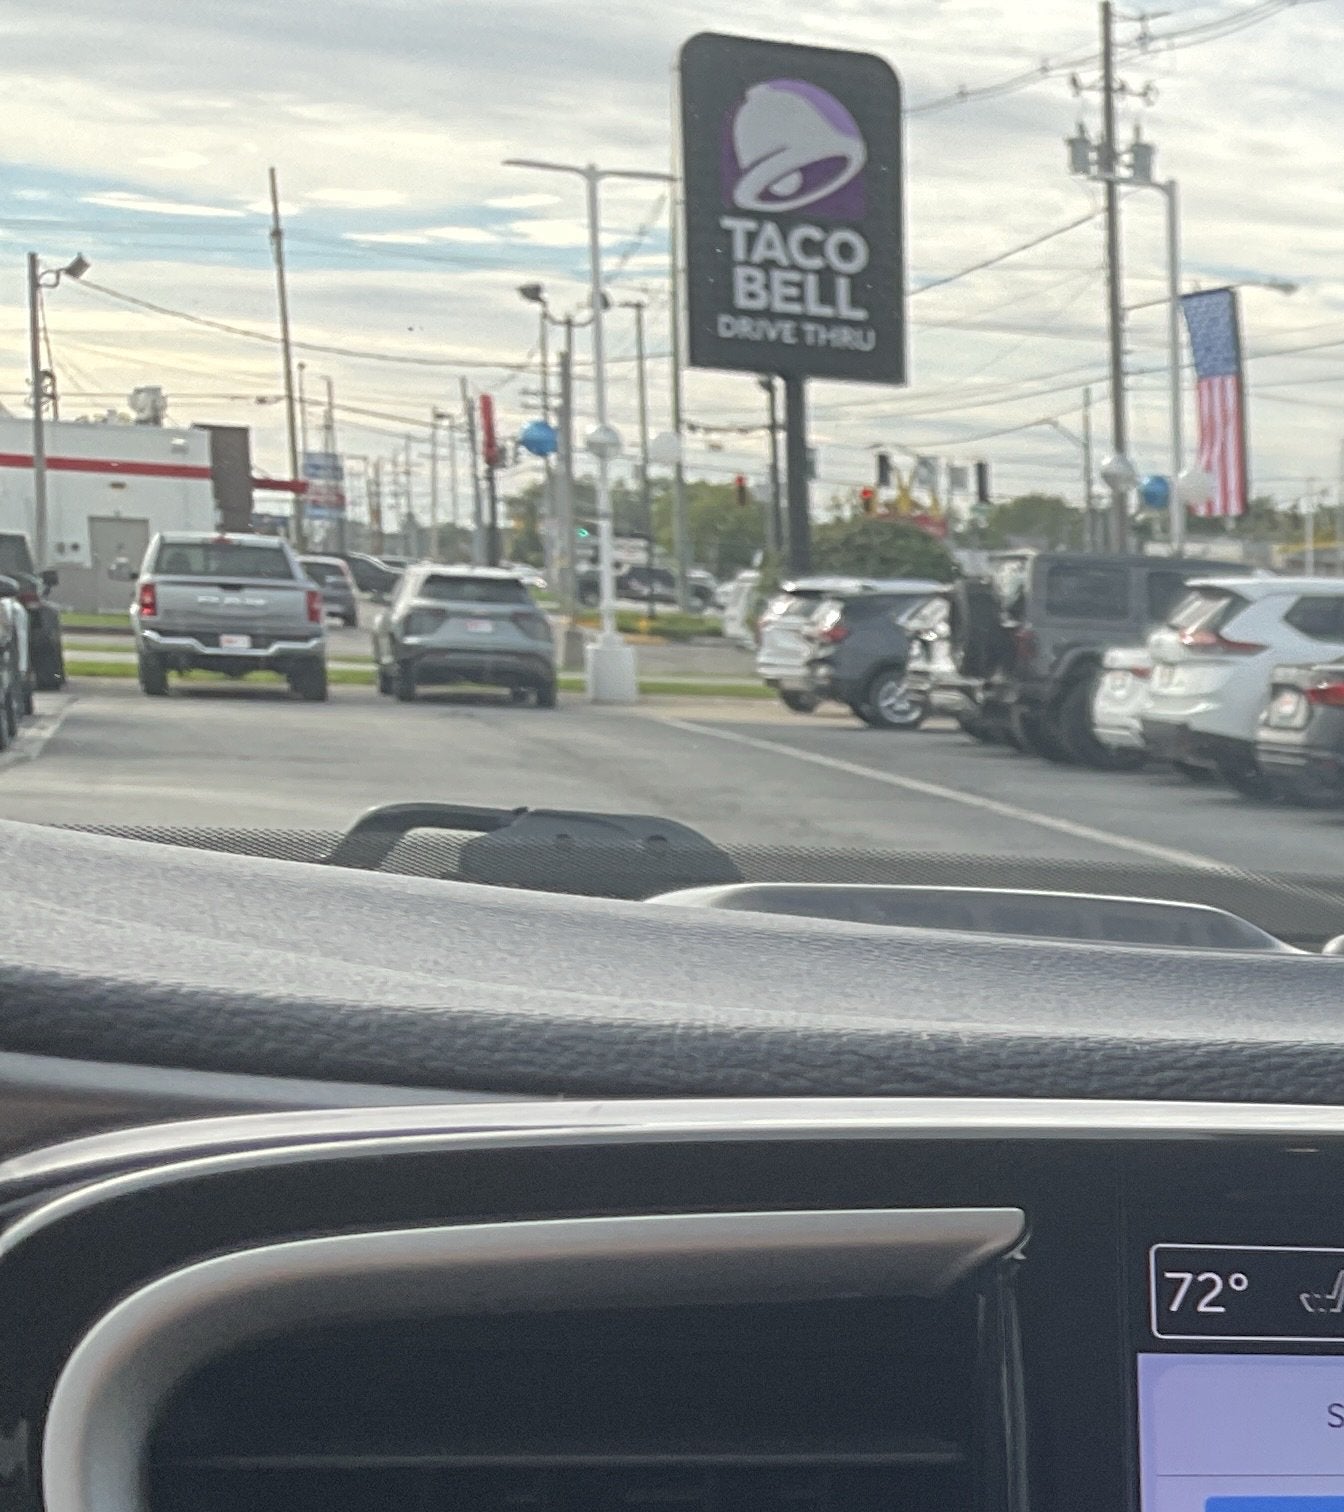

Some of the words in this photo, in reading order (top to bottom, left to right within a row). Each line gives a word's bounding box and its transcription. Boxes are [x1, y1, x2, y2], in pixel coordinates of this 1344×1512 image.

[718, 215, 870, 275] TACO
[733, 265, 869, 321] BELL
[717, 313, 799, 345] DRIVE
[801, 321, 876, 351] THRU
[1163, 1271, 1248, 1313] 72°
